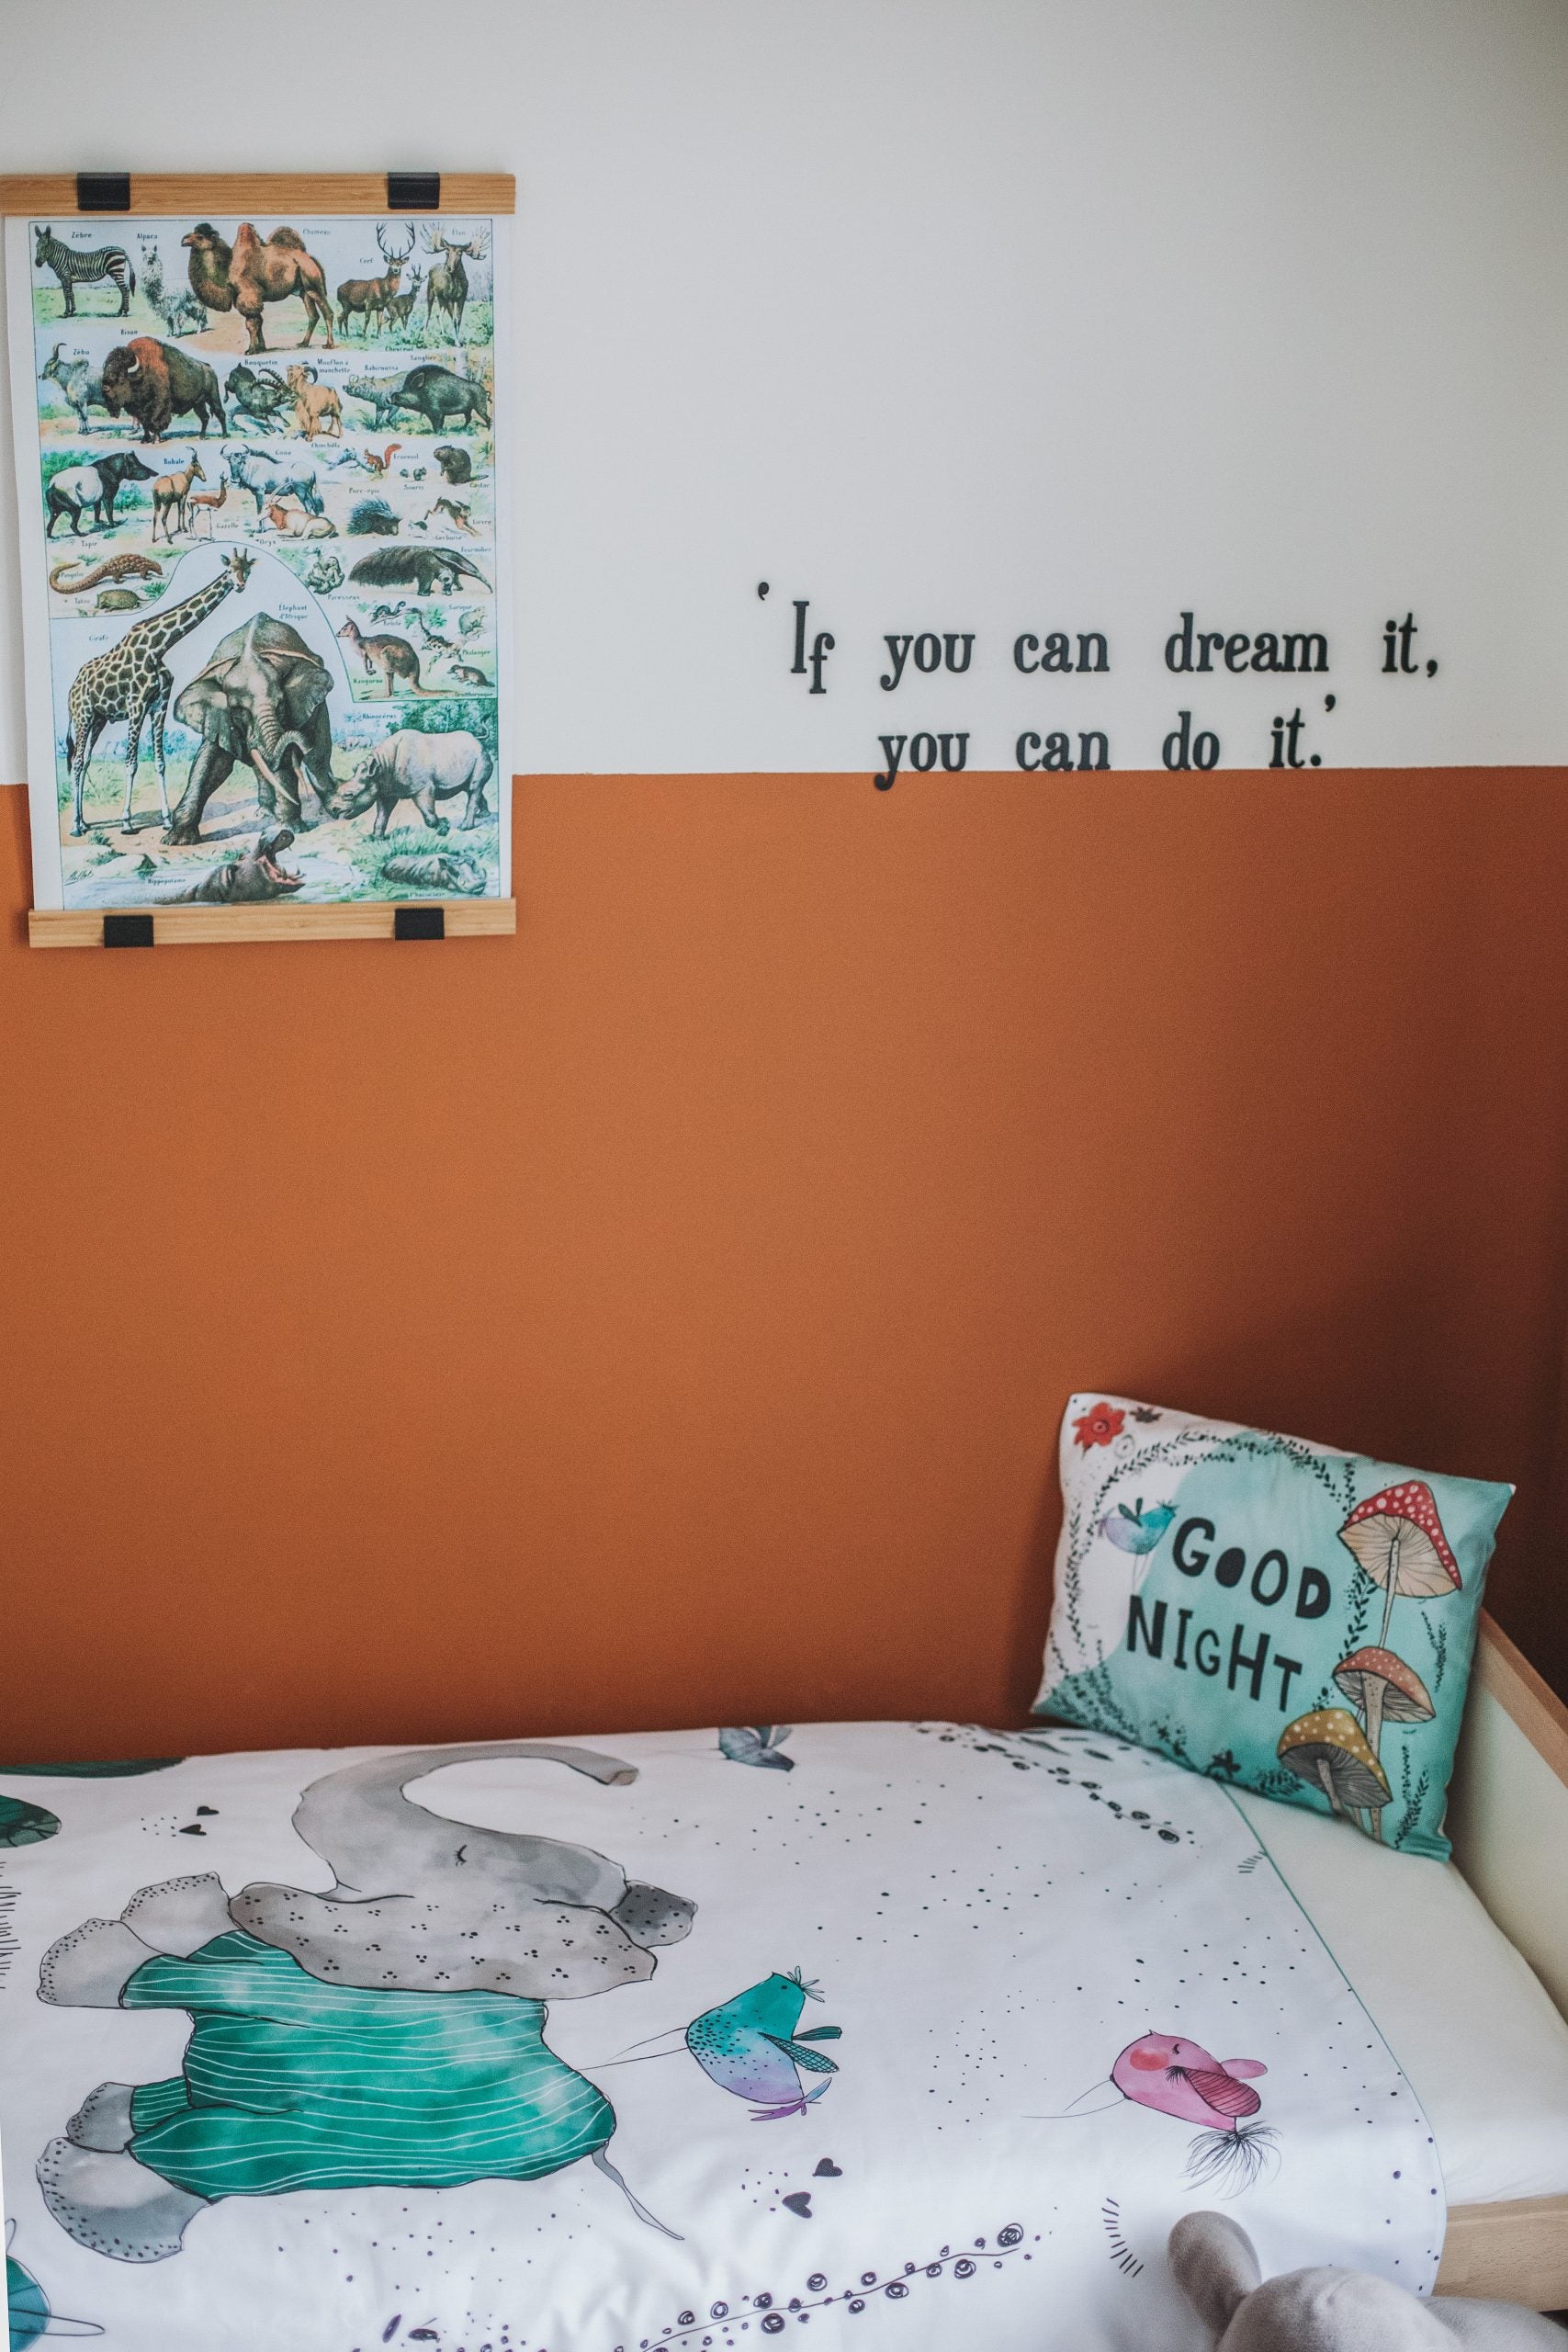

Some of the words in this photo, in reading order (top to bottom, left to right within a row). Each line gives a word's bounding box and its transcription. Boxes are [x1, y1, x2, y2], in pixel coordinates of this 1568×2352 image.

[880, 633, 975, 691] you
[1013, 633, 1110, 673] can
[1166, 612, 1329, 673] dream
[1382, 613, 1438, 679] it,
[874, 732, 971, 791] you
[1015, 731, 1110, 771] can
[1162, 711, 1220, 771] do
[1126, 1595, 1303, 1712] NIGHT
